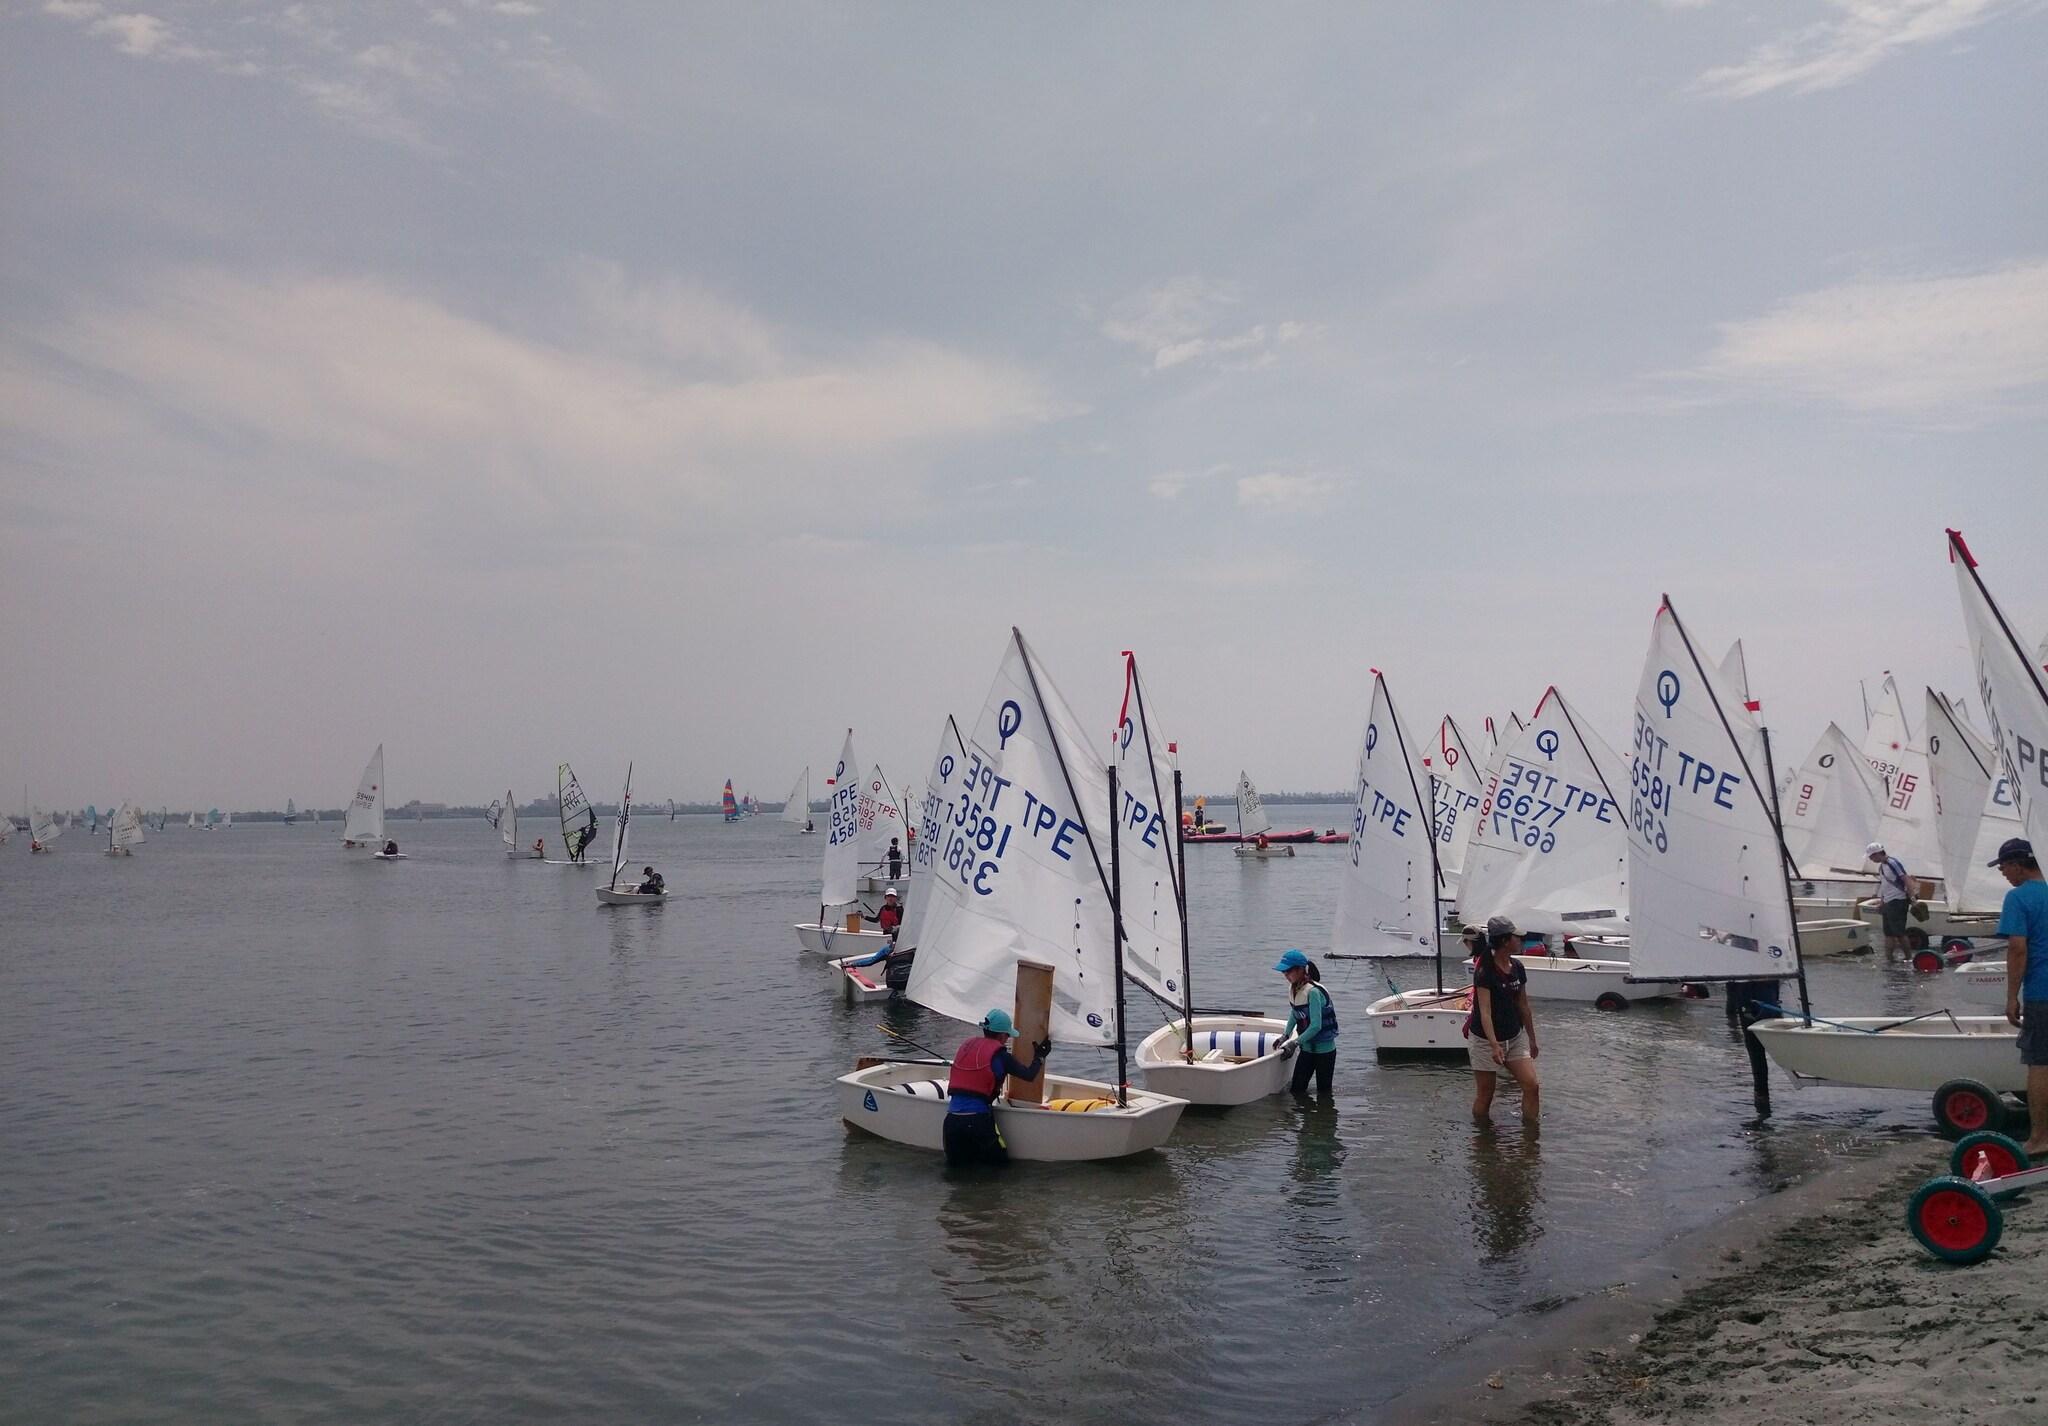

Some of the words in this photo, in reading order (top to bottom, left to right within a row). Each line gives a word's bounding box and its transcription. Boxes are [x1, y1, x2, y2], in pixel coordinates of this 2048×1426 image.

[832, 784, 857, 809] TPE
[1455, 790, 1480, 811] TP
[1632, 757, 1671, 816] 6581
[1678, 751, 1740, 810] TPE
[878, 803, 897, 818] TPE
[1123, 790, 1165, 848] TPE
[1372, 790, 1412, 837] TPE
[1497, 788, 1566, 828] 6677
[1564, 784, 1617, 823] TPE
[830, 819, 857, 846] 4581
[955, 794, 1012, 858] 3581
[1023, 790, 1086, 861] TPE
